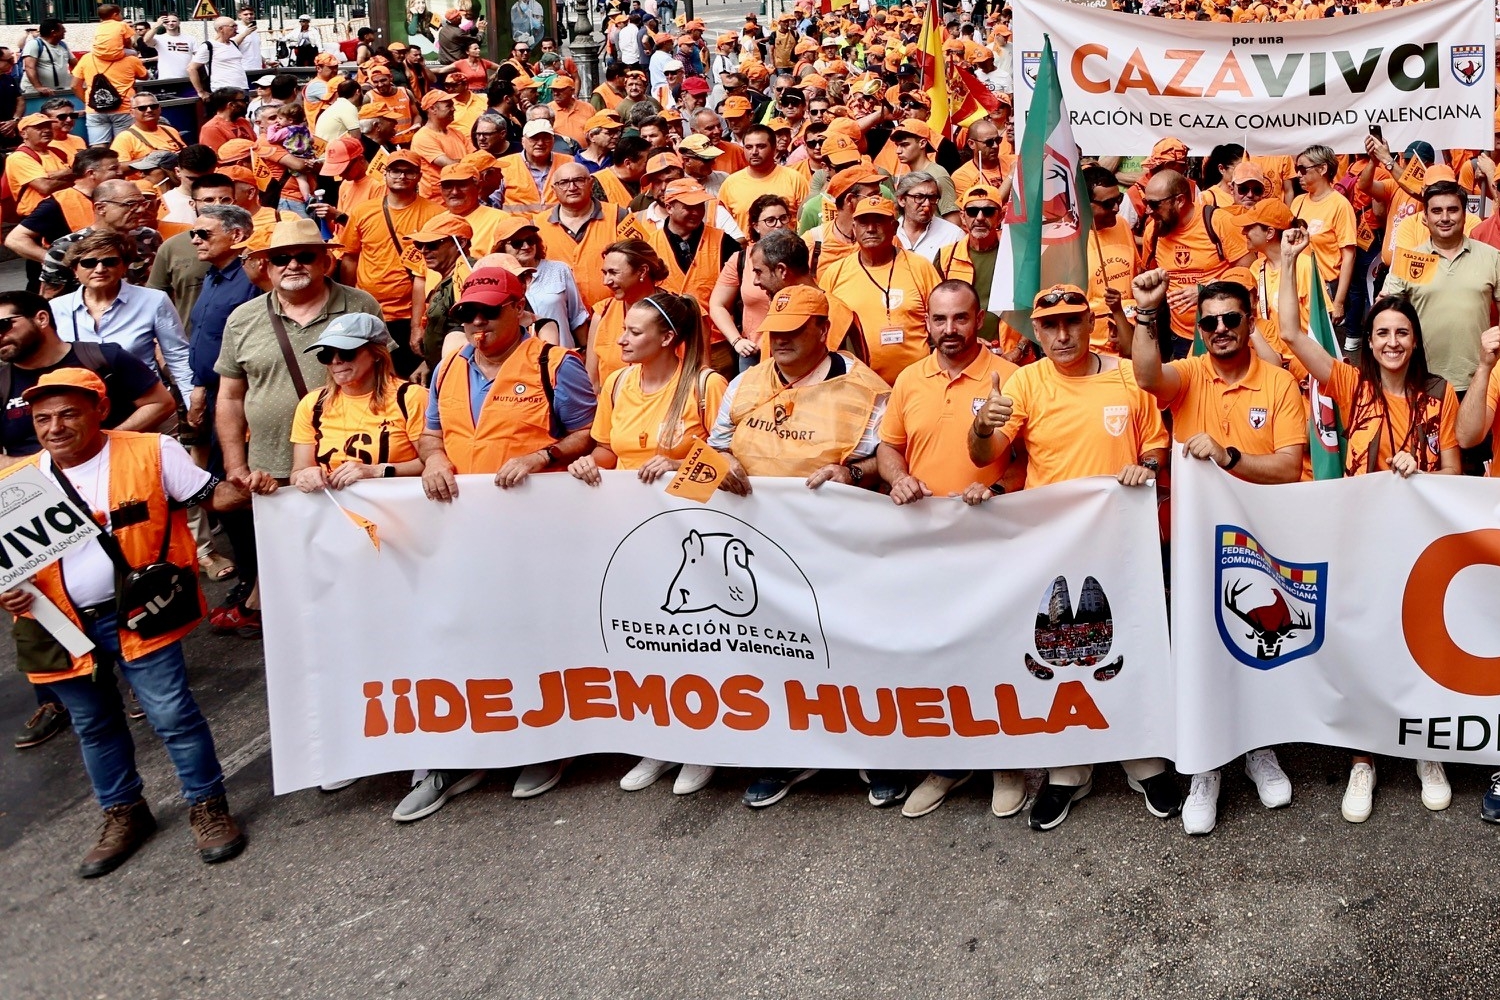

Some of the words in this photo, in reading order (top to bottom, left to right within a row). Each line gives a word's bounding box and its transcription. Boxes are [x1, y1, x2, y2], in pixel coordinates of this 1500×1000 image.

[1232, 36, 1255, 47] por
[1258, 36, 1285, 45] una
[1150, 113, 1173, 128] DE
[1178, 114, 1229, 130] CAZA
[1235, 110, 1357, 130] COMUNIDAD
[1364, 104, 1482, 124] VALENCIANA
[1177, 276, 1197, 284] 2015
[683, 467, 691, 475] LA
[689, 447, 703, 465] CAZA
[46, 526, 95, 556] VALENCIANA
[1221, 556, 1271, 575] COMUNIDAD
[1293, 582, 1318, 592] CAZA
[613, 617, 732, 637] FEDERACIÓN
[737, 624, 758, 639] DE
[764, 627, 812, 645] CAZA
[625, 634, 721, 653] Comunidad
[726, 637, 816, 660] Valenciana
[787, 680, 1109, 738] HUELLA
